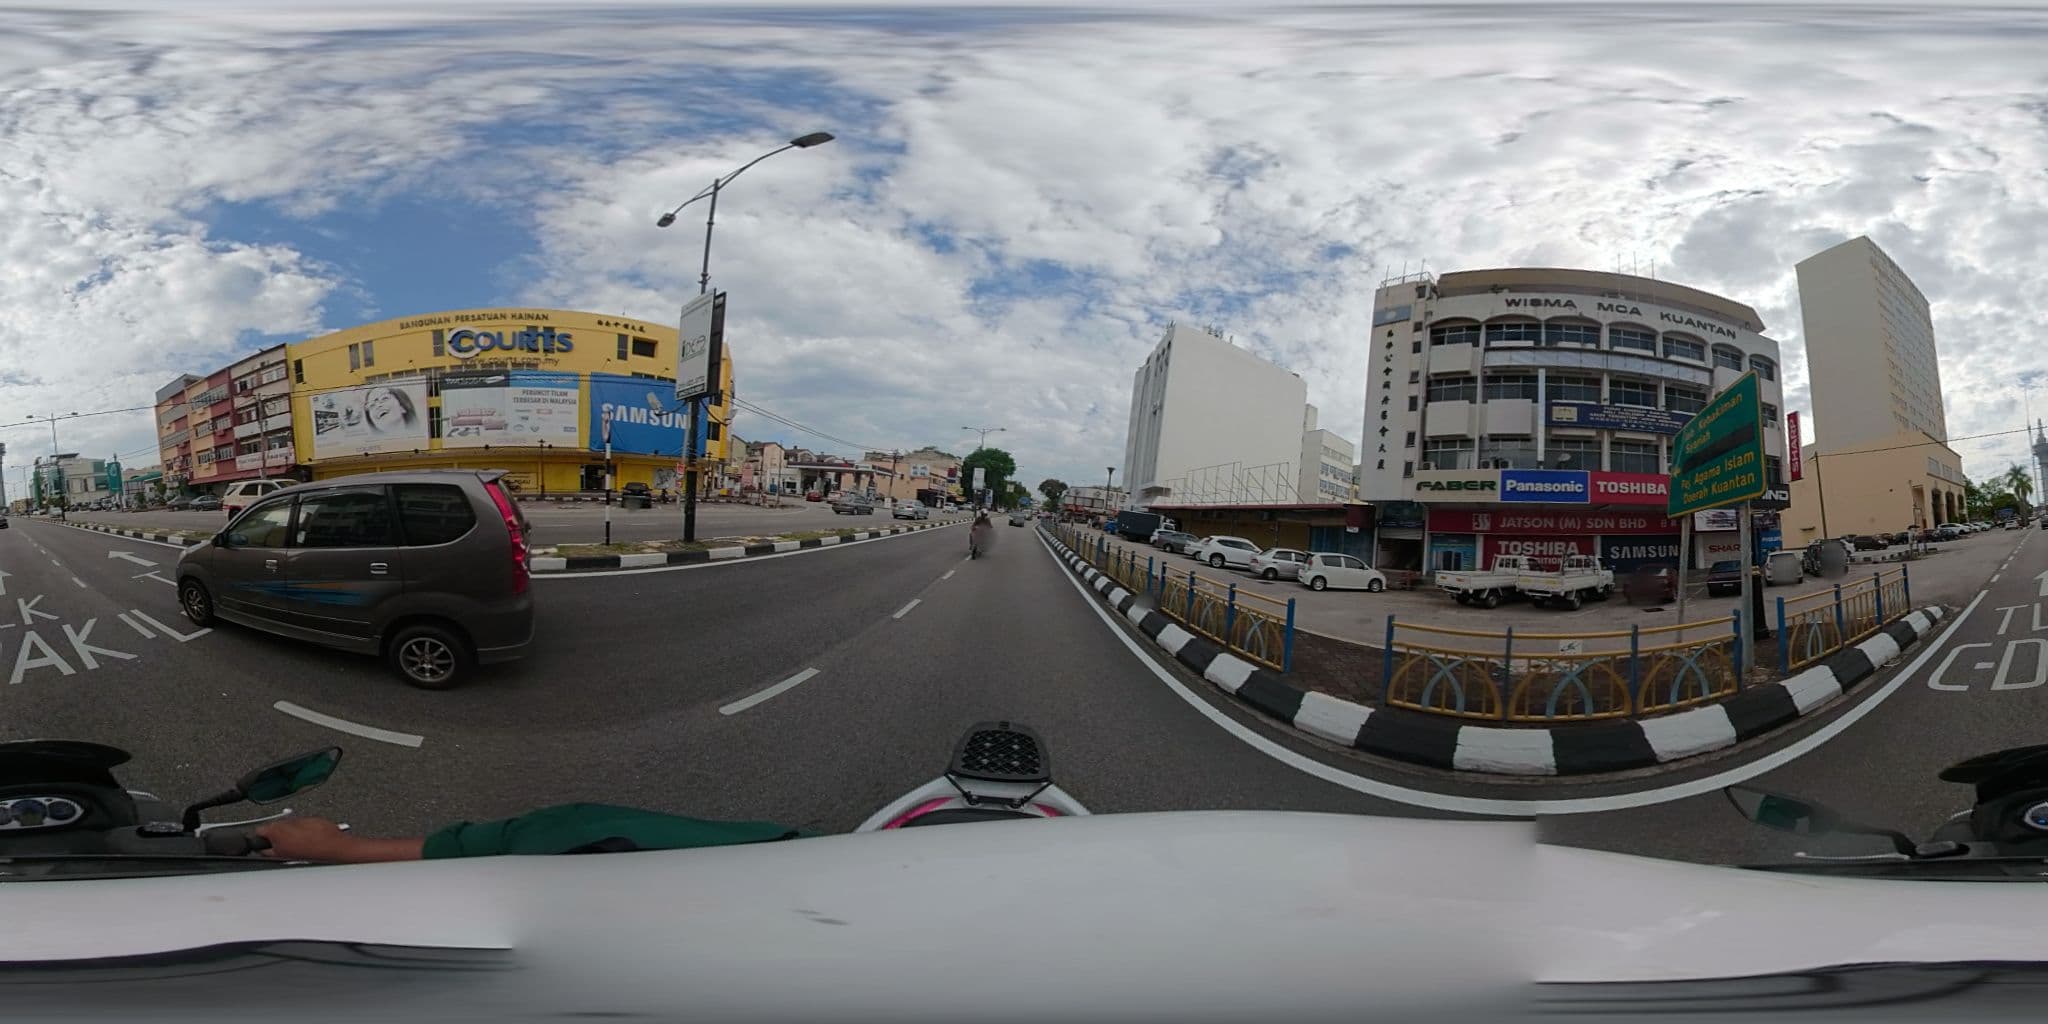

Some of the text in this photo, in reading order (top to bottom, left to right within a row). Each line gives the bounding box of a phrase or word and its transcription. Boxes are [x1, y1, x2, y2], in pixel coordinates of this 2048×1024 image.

[400, 313, 549, 330] BANGUNAN PERSATUAN HAINAN
[1505, 297, 1736, 339] WISMA MCA KUANTAN
[449, 328, 574, 355] COURTS
[601, 403, 688, 429] SAMSUN
[1788, 418, 1800, 473] SHARP
[1694, 466, 1721, 486] Agama
[1724, 451, 1755, 472] Islam
[1416, 480, 1496, 491] FABER
[1506, 480, 1584, 492] Panasonic
[1597, 481, 1667, 495] TOSHIBA
[1711, 472, 1755, 495] Kuantan
[1499, 516, 1554, 528] JATSON
[1559, 516, 1581, 529] (M)
[1587, 518, 1614, 528] SDN
[1619, 518, 1647, 529] BHD
[1497, 540, 1579, 556] TOSHIBA
[1610, 544, 1679, 560] SAMSUN
[1708, 543, 1741, 554] SHAR
